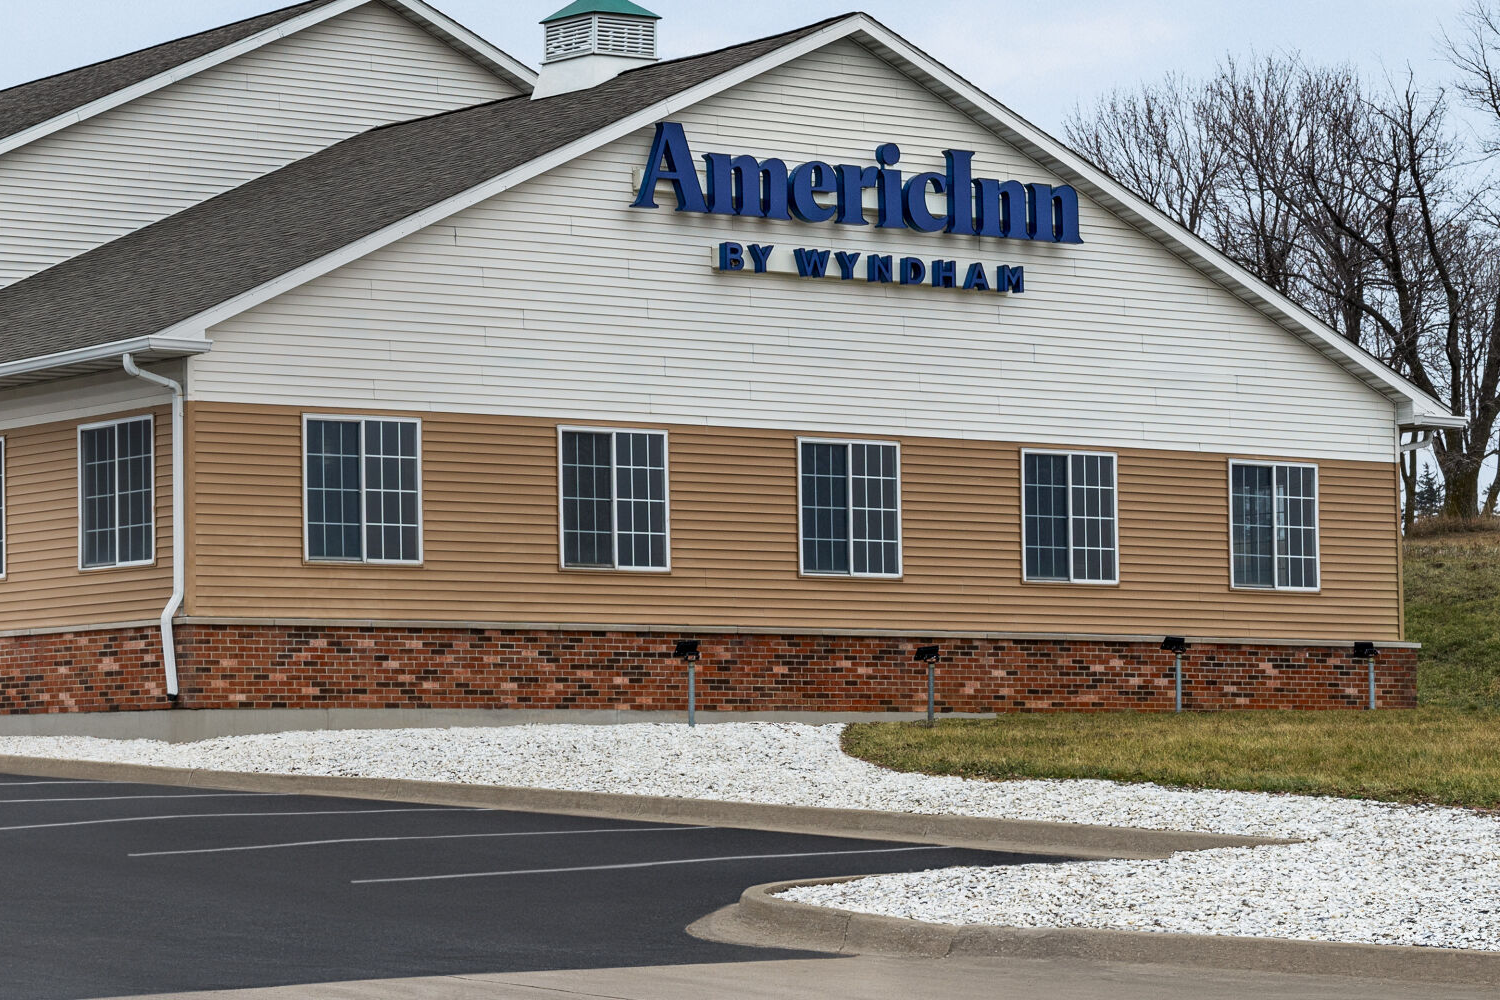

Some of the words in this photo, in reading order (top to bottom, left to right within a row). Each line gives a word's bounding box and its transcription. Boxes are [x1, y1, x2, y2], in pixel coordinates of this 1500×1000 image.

[630, 121, 1085, 244] AmericInn
[718, 241, 774, 273] BY
[793, 248, 1025, 293] WYNDHAM
